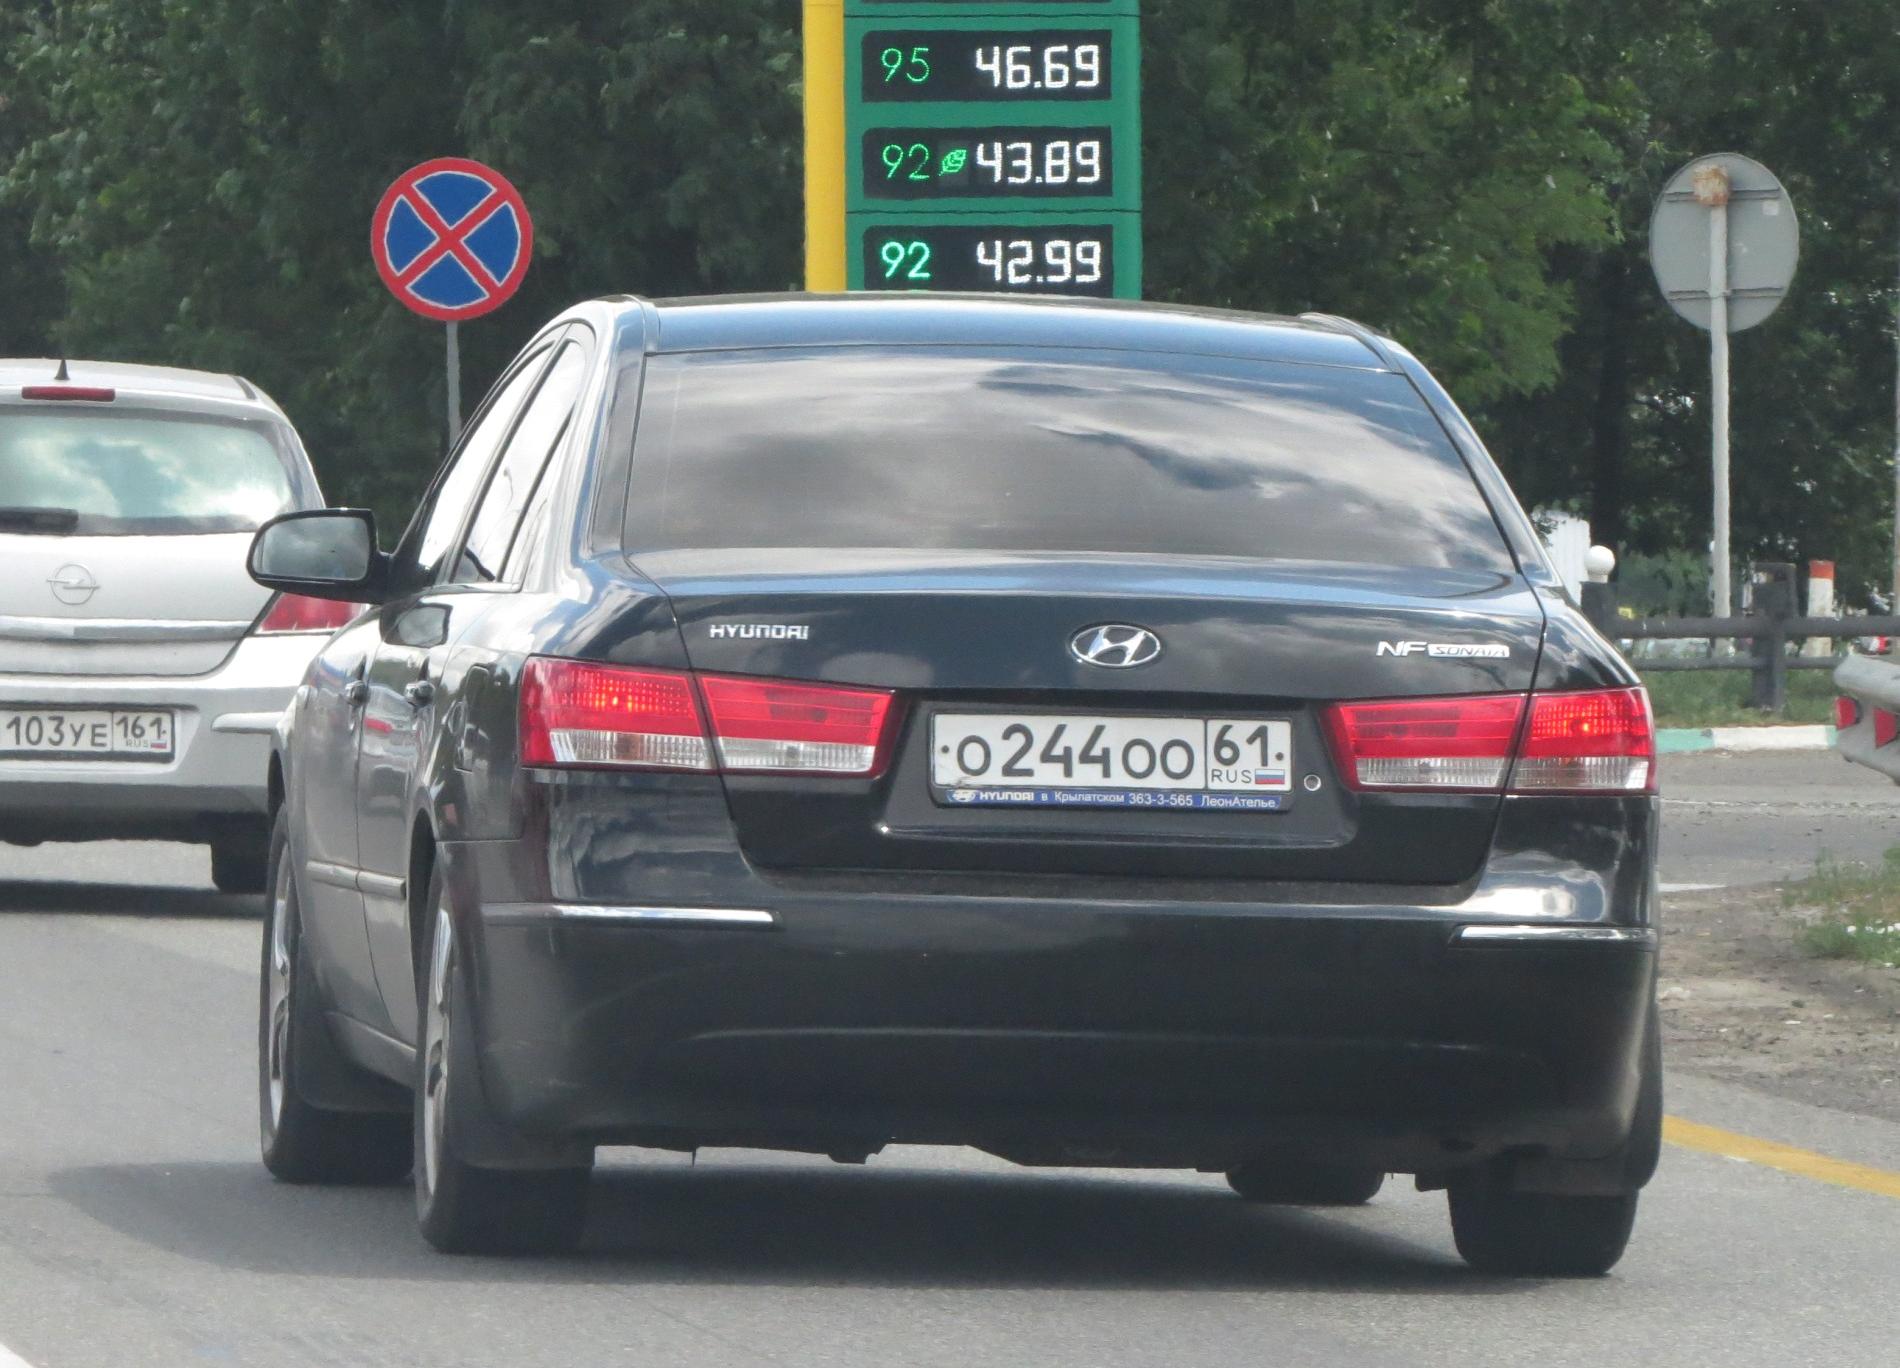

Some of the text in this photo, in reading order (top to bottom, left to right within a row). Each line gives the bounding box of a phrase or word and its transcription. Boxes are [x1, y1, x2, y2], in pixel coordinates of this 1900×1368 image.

[881, 45, 1099, 88] 95 46.69
[882, 141, 1100, 183] 92 43.89
[881, 240, 1101, 283] 92 42.99
[710, 624, 809, 640] HYUNDAI
[1376, 641, 1507, 657] NF SONATA
[126, 739, 148, 747] RUS
[1213, 724, 1269, 767] 61
[1211, 769, 1252, 784] RUS
[980, 791, 1034, 801] HYUNDAI
[1055, 791, 1124, 805] Крылатском
[1129, 793, 1193, 806] 363-3-565
